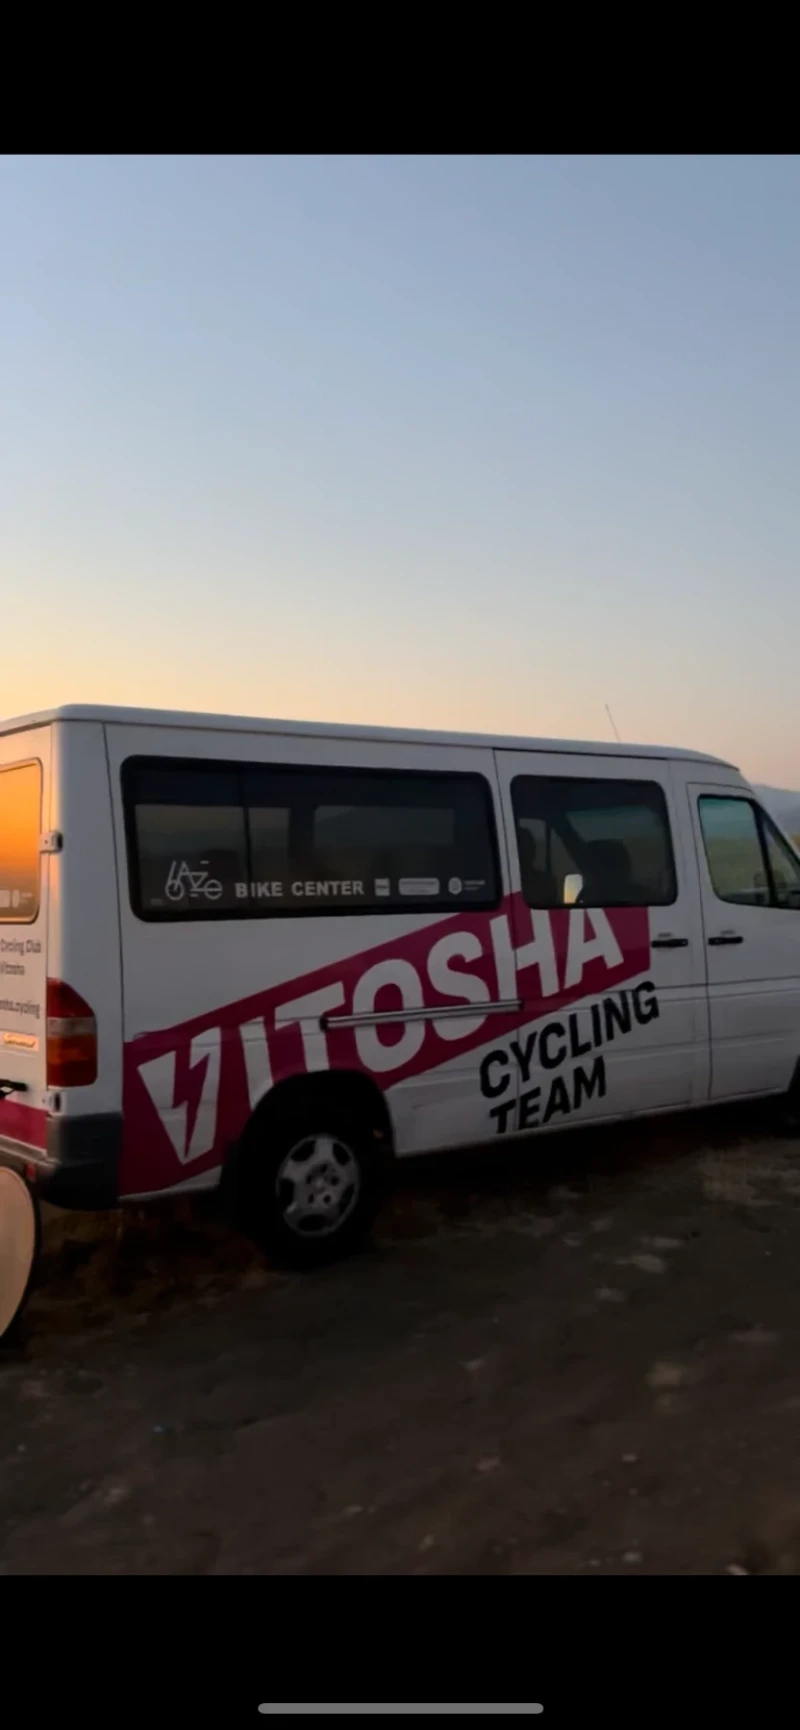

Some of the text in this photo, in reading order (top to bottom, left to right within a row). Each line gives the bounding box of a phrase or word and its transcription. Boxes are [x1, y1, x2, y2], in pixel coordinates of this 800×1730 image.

[235, 881, 283, 898] BIKE
[291, 880, 364, 896] CENTER
[25, 939, 42, 954] Club
[137, 906, 625, 1166] VITOSHA
[479, 981, 660, 1099] CYCLING
[489, 1055, 607, 1134] TEAM
